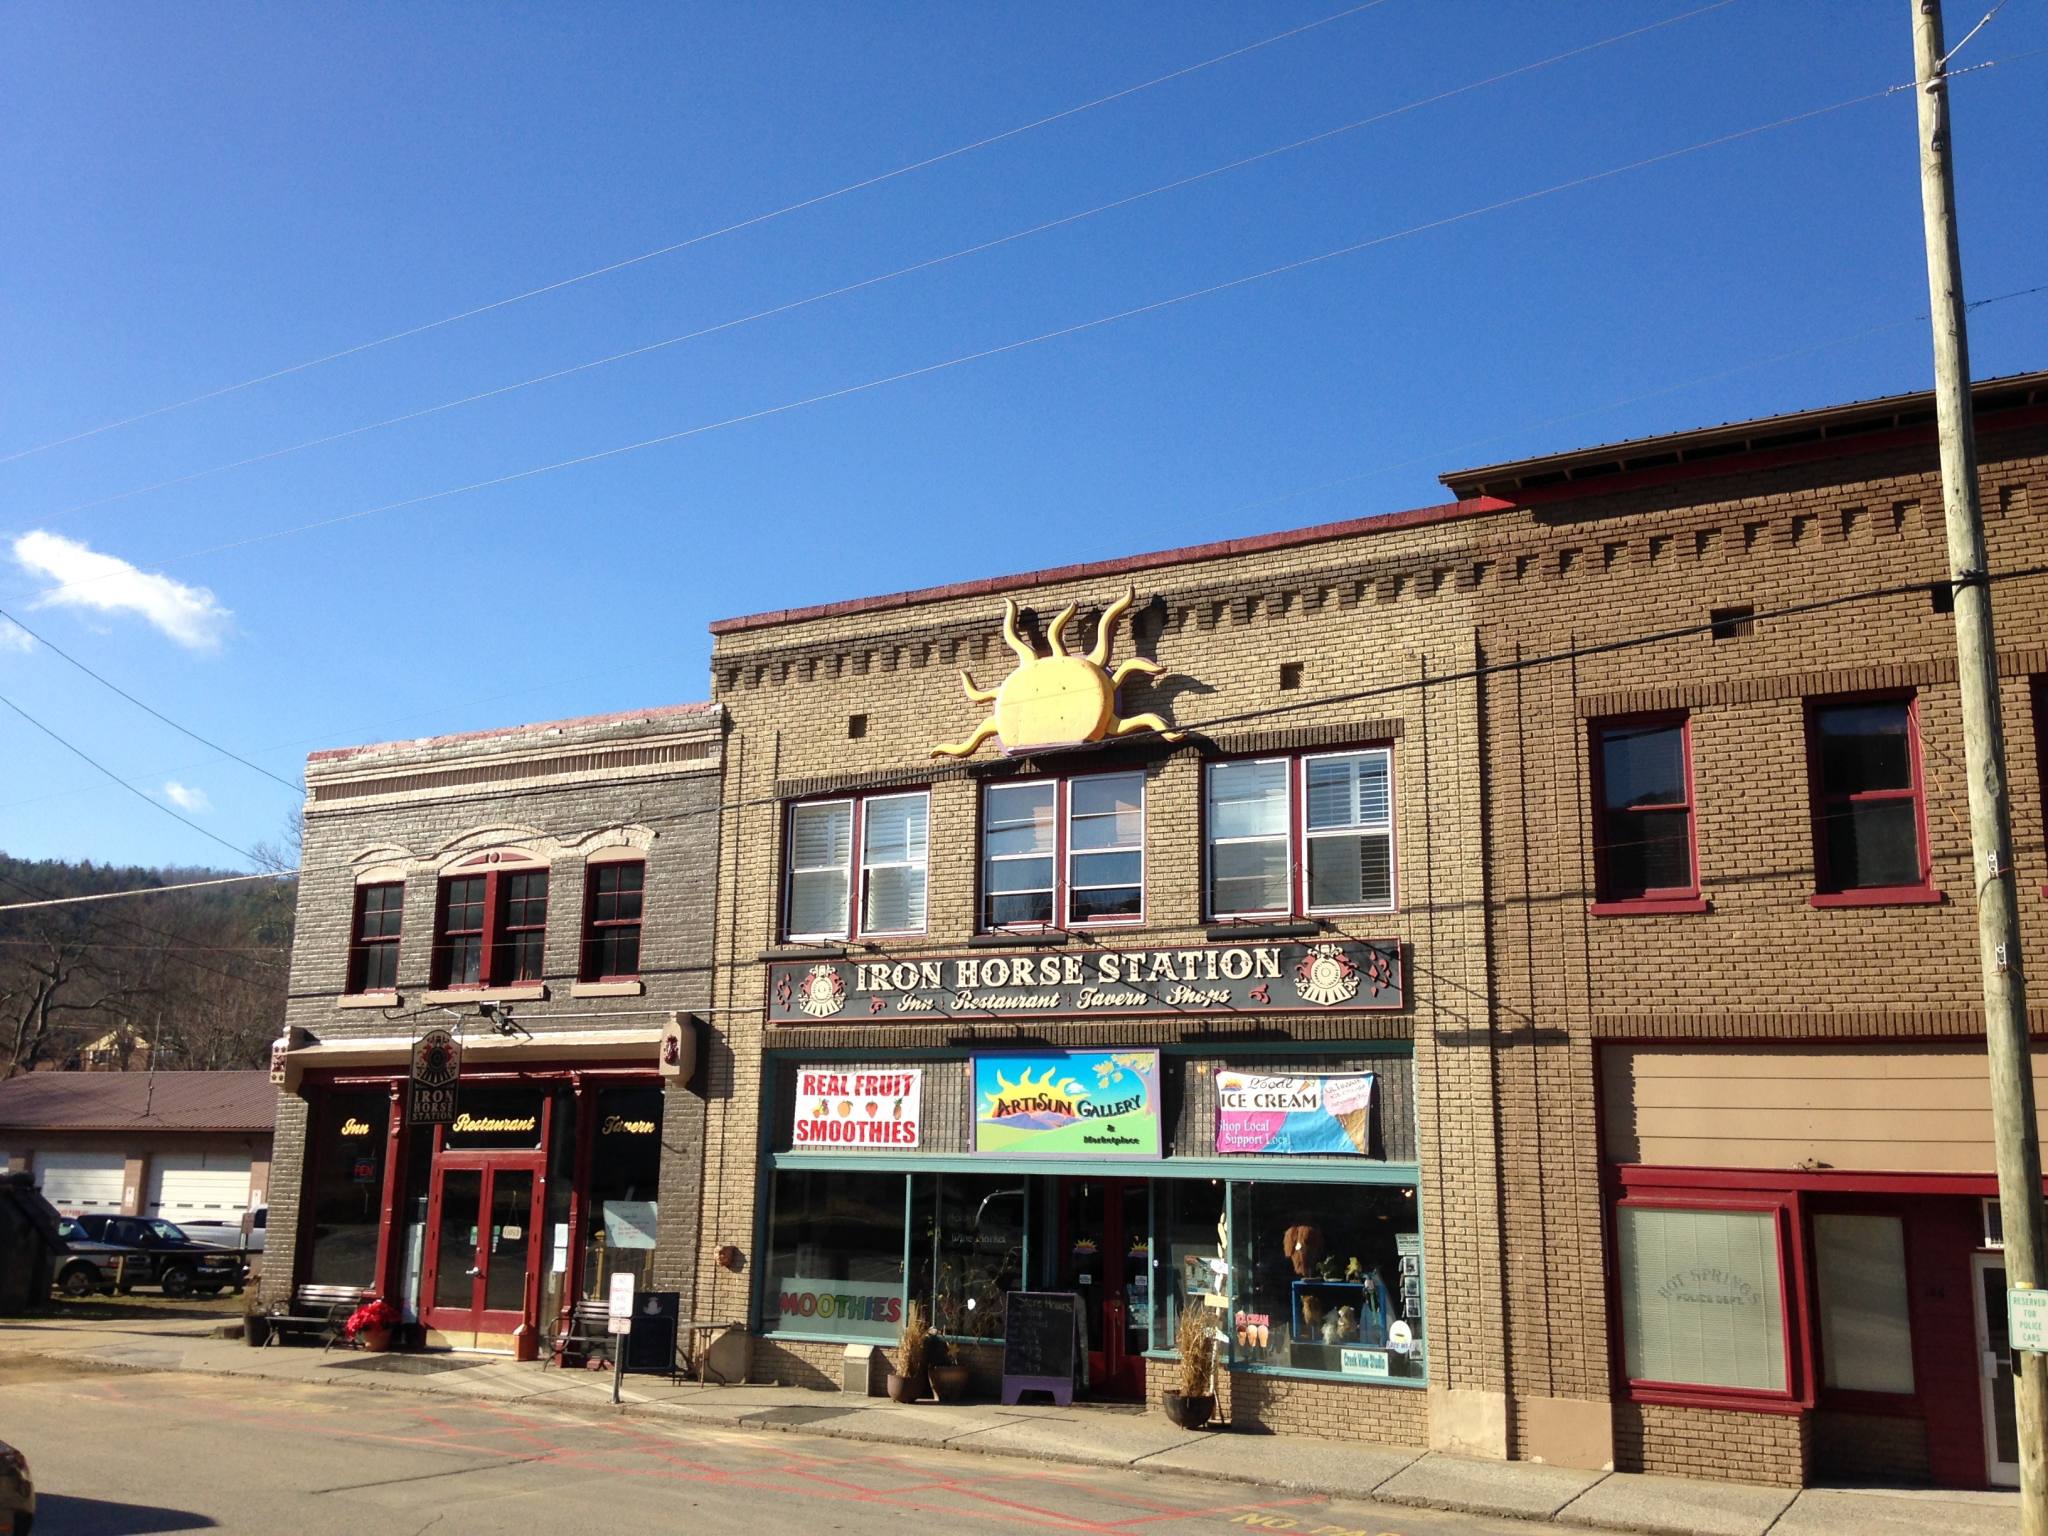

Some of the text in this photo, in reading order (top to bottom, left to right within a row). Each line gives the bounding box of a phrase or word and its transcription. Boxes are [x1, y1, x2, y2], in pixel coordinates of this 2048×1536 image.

[855, 947, 1283, 991] IRON HORSE STATION
[897, 984, 1231, 1012] Inn Restaurant Tavern Shops
[803, 1074, 914, 1097] REAL FRUIT
[415, 1090, 454, 1103] IRON
[1221, 1093, 1247, 1108] ICE
[1254, 1093, 1317, 1109] CREAM
[413, 1102, 453, 1113] HORSE
[412, 1112, 454, 1121] STATION
[452, 1112, 536, 1133] Restaurant
[341, 1117, 370, 1136] Inn
[601, 1115, 656, 1135] Tavern
[796, 1119, 916, 1144] SMOOTHIES
[1244, 1119, 1270, 1132] Local
[1083, 1135, 1141, 1147] Marketplace
[1225, 1132, 1292, 1148] Support Local
[1689, 1268, 1761, 1305] SPRINGS
[778, 1291, 902, 1323] MOOTHIES
[2013, 1296, 2047, 1307] RESERVED
[2019, 1321, 2042, 1331] POLICE
[2022, 1333, 2041, 1343] CARS
[1230, 1512, 1300, 1529] NO
